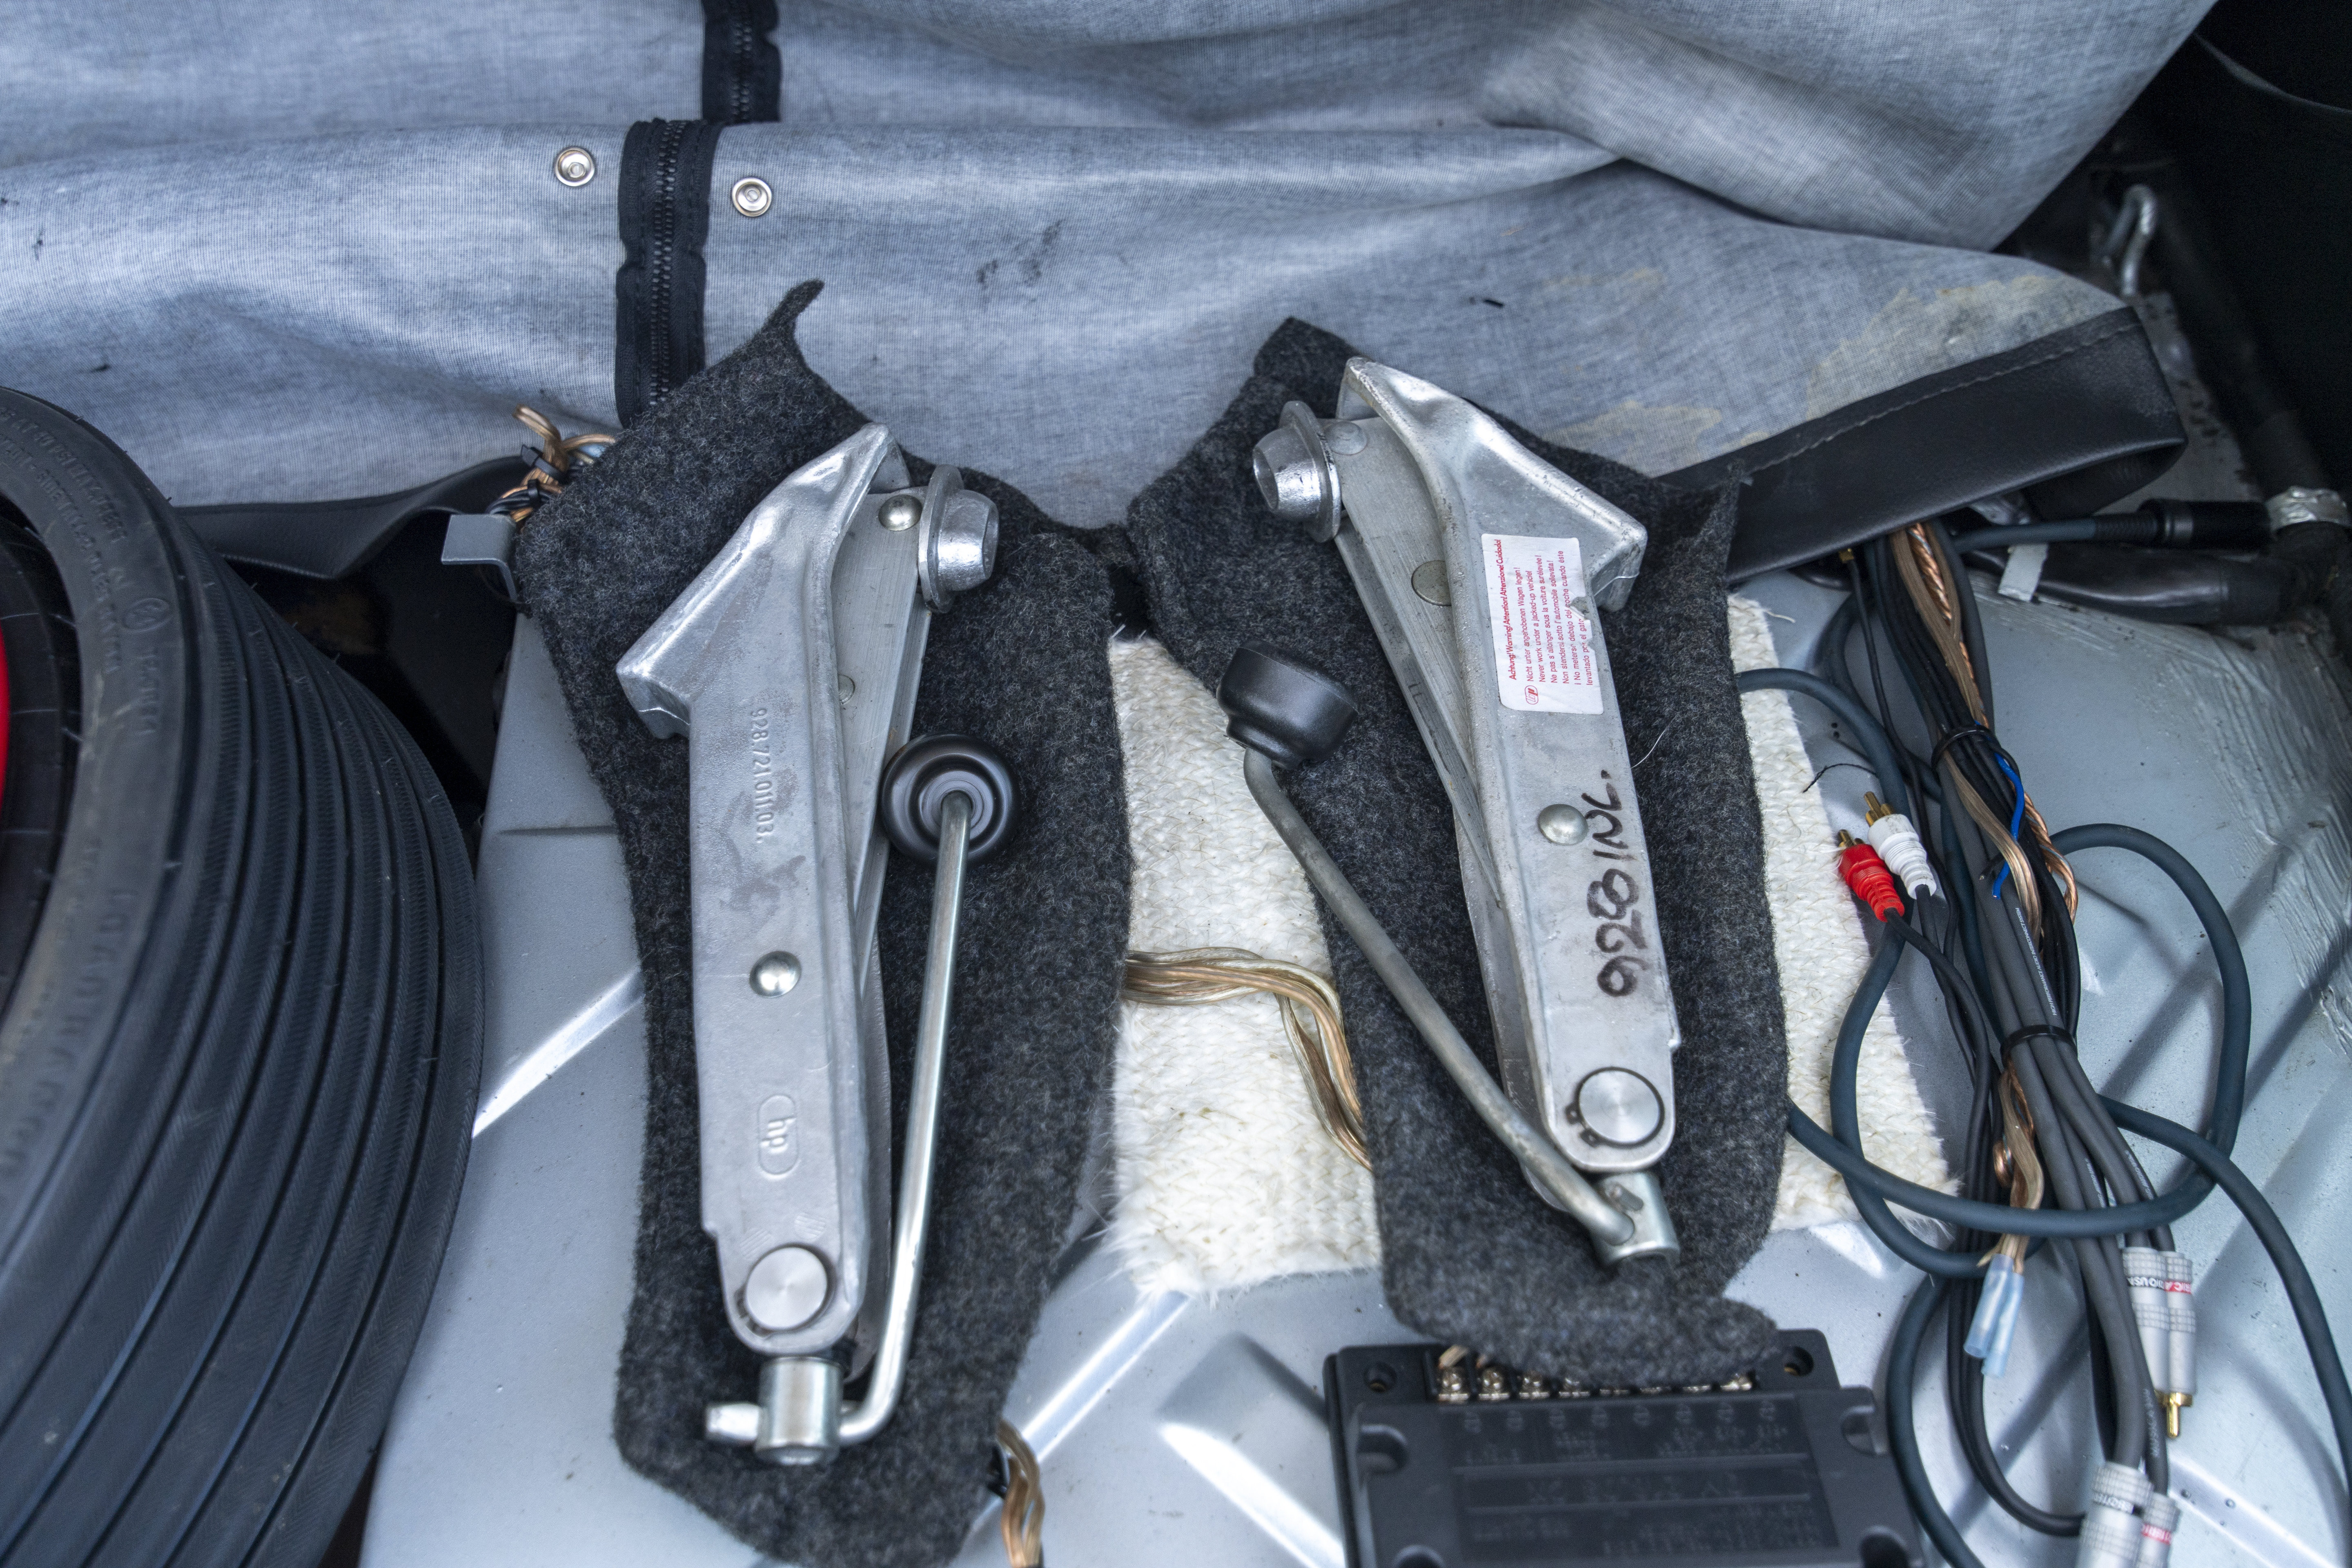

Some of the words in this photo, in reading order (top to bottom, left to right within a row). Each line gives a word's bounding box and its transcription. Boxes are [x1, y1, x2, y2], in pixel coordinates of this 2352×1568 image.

[1559, 566, 1568, 586] cuando
[1517, 587, 1525, 606] Wagen
[1529, 593, 1539, 621] jacked-up
[1520, 608, 1530, 646] angehobenen
[1567, 621, 1575, 641] debajo
[1525, 666, 1533, 682] Nicht
[1551, 674, 1557, 683] Ne
[1574, 672, 1581, 680] No
[1584, 655, 1592, 686] levantado
[2015, 907, 2025, 923] SYSTEM
[1586, 867, 1650, 997] 928
[2021, 923, 2036, 955] INTERCONNECT
[2032, 955, 2041, 970] AUDIO
[2038, 970, 2053, 1002] PERFORMANCE
[2049, 1002, 2058, 1016] HIGH
